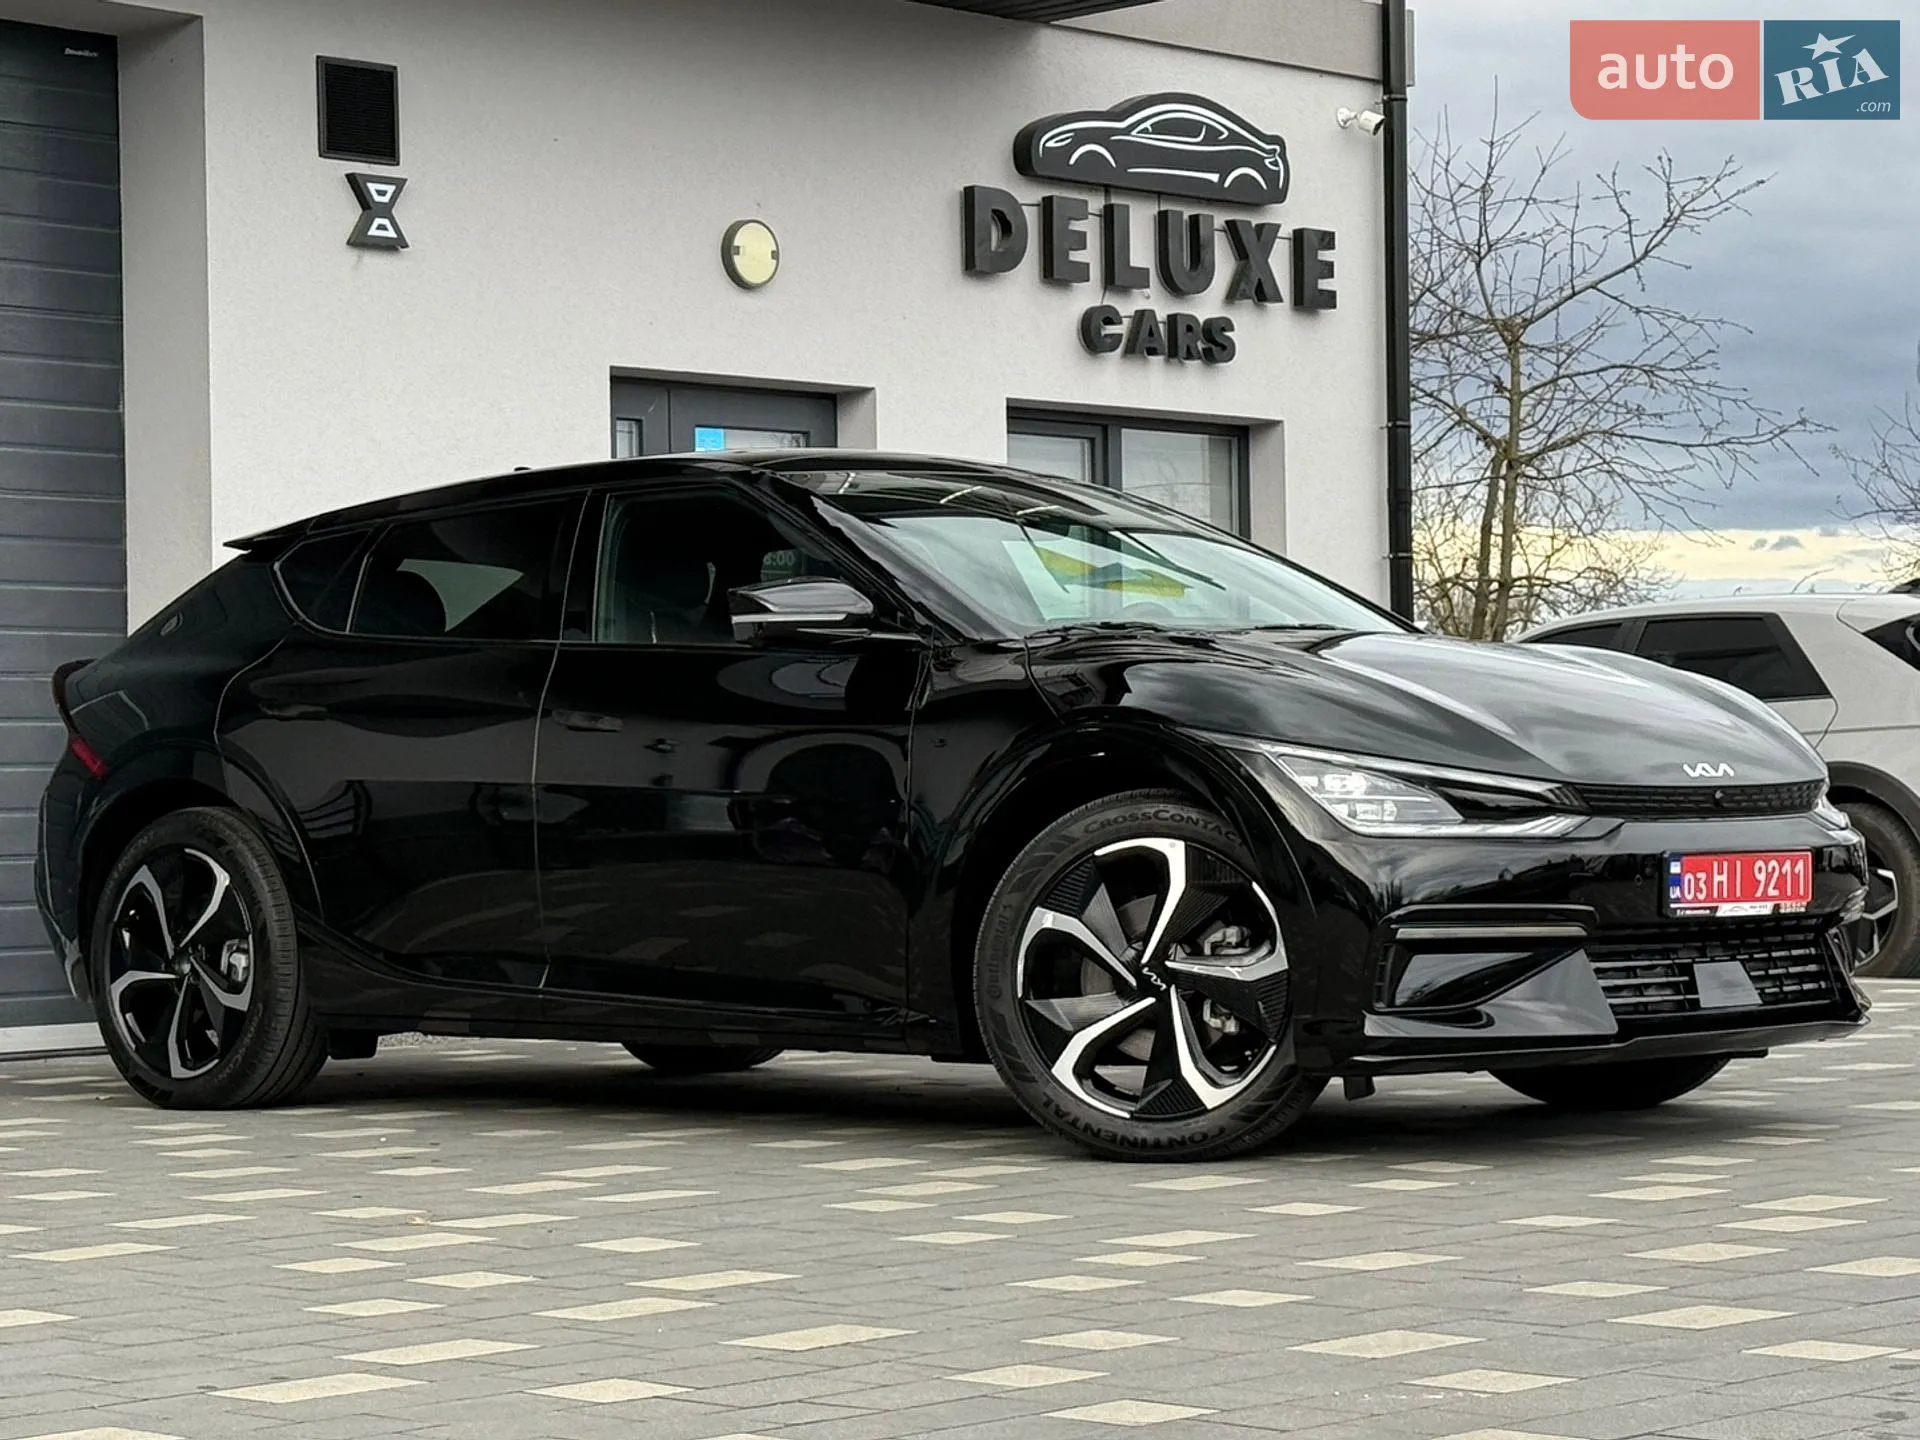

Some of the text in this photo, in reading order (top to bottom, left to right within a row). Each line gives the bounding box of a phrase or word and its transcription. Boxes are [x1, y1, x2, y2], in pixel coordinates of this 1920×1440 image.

[962, 185, 1337, 310] DELUXE
[1080, 304, 1236, 364] CARS
[1669, 859, 1805, 900] UA 03 HI 9211
